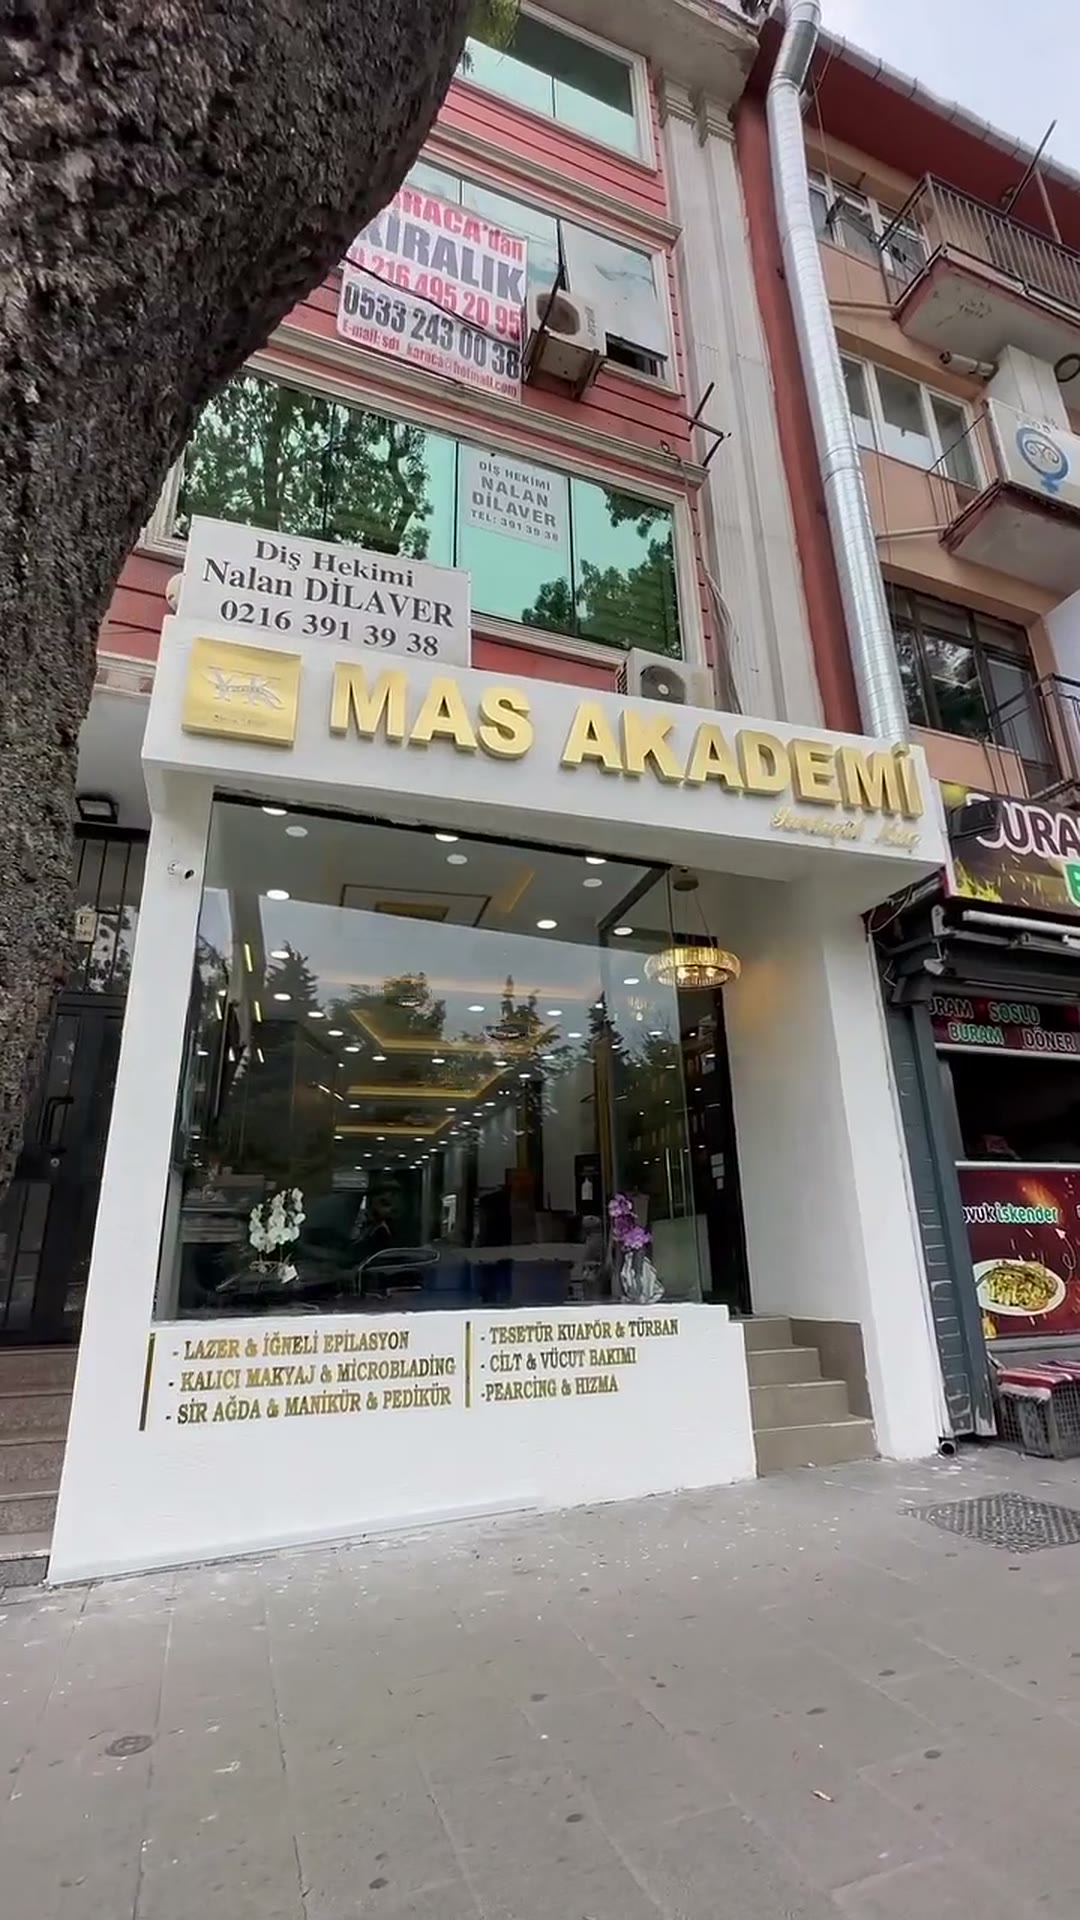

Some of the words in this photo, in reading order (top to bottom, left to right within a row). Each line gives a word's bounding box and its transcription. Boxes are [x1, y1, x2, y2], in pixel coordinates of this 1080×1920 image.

[415, 273, 458, 315] 495
[463, 290, 490, 327] 20
[495, 304, 521, 342] 95
[342, 319, 381, 346] E-mail:
[343, 280, 407, 334] 0533
[410, 306, 454, 351] 243
[458, 326, 487, 368] 00
[491, 342, 520, 380] 38
[472, 490, 556, 528] DİLAVER
[481, 476, 548, 508] NALAN
[471, 508, 497, 524] TEL:
[525, 524, 540, 537] 39
[255, 539, 301, 571] Diş
[313, 551, 414, 588] Hekimi
[203, 558, 293, 598] Nalan
[305, 576, 454, 628] DİLAVER
[220, 599, 292, 631] 0216
[302, 613, 350, 641] 391
[363, 625, 397, 648] 39
[406, 632, 439, 657] 38
[329, 660, 534, 759] MAS
[559, 701, 923, 818] AKADEMİ
[947, 1022, 1005, 1047] BURAM
[1022, 1027, 1077, 1053] DÖNER
[995, 1202, 1058, 1223] iskender
[184, 1339, 240, 1361] LAZER
[245, 1338, 258, 1358] &
[262, 1330, 319, 1357] İĞNELİ
[324, 1329, 410, 1354] EPİLASYON
[489, 1321, 554, 1345] TESETÜR
[558, 1319, 612, 1341] KUAFÖR
[615, 1321, 625, 1338] &
[628, 1316, 679, 1338] TÜRBAN
[180, 1369, 241, 1392] KALICI
[245, 1364, 316, 1388] MAKYAJ
[320, 1364, 332, 1383] &
[337, 1354, 456, 1382] MİCROBLADİNG
[490, 1350, 522, 1373] CİLT
[526, 1353, 537, 1370] &
[540, 1347, 586, 1369] VÜCUT
[590, 1347, 637, 1366] BAKIMI
[561, 1379, 571, 1396] &
[575, 1375, 618, 1395] HIZMA
[177, 1397, 208, 1425] SİR
[212, 1395, 261, 1422] AĞDA
[266, 1398, 279, 1418] &
[284, 1389, 361, 1417] MANİKÜR
[366, 1391, 378, 1411] &
[383, 1382, 451, 1409] PEDİKÜR
